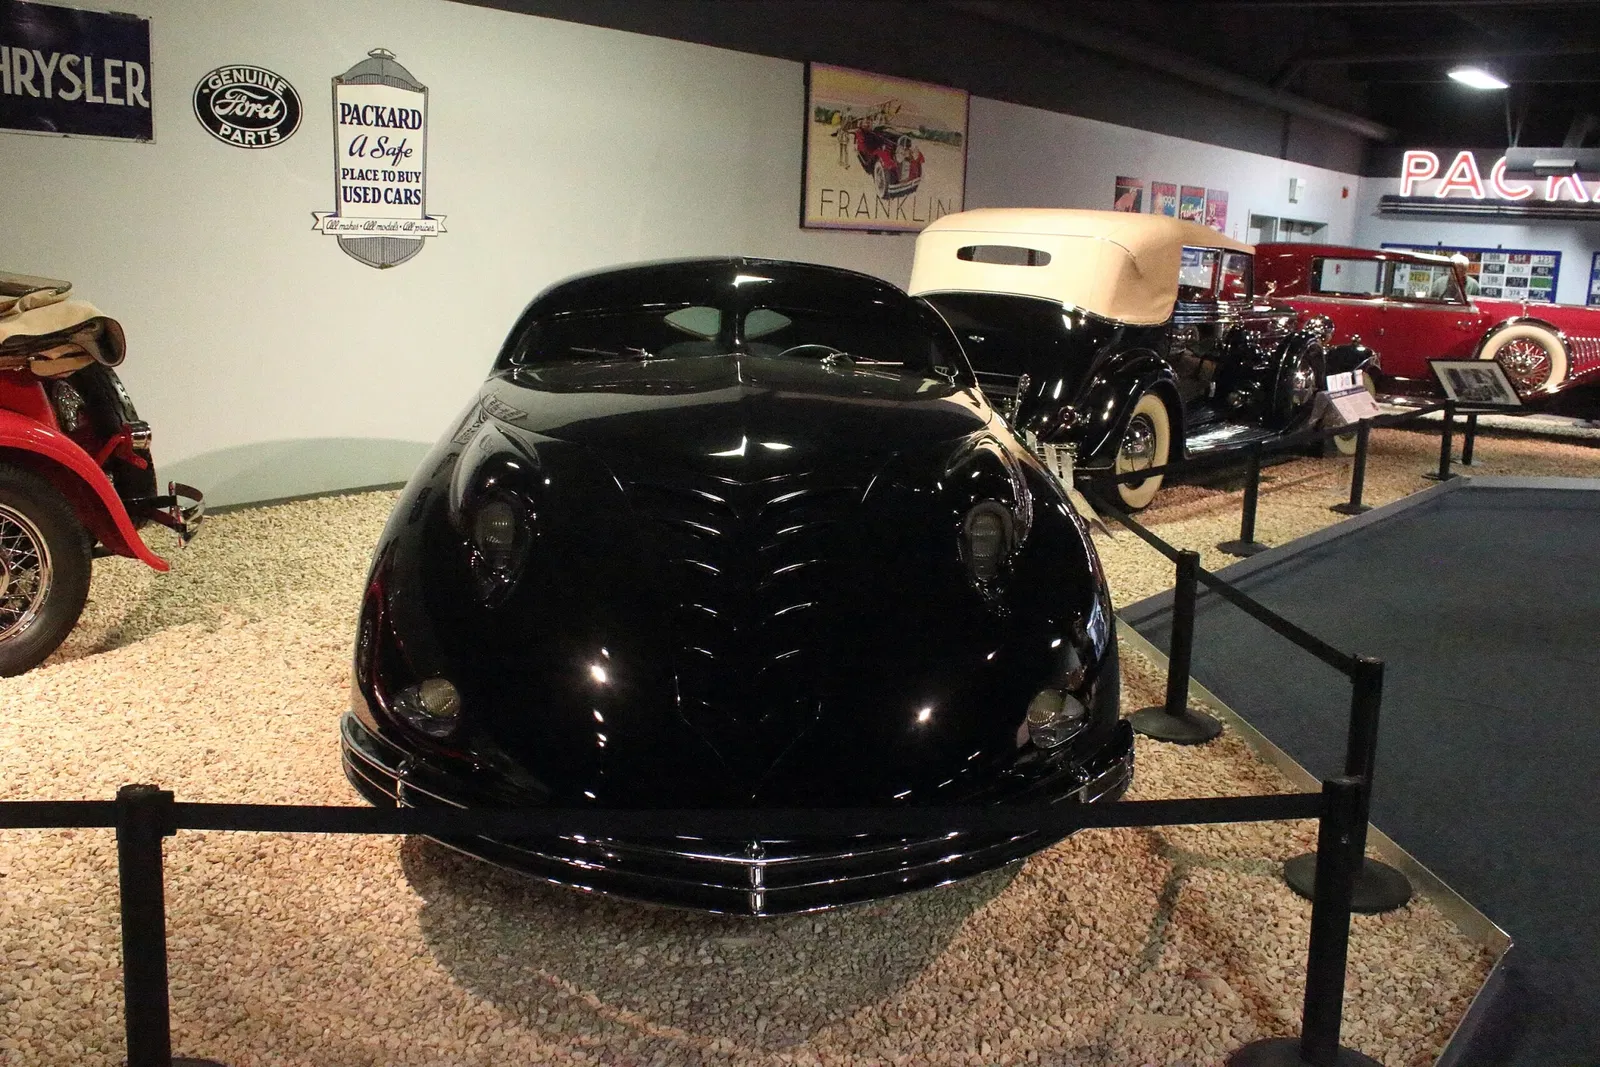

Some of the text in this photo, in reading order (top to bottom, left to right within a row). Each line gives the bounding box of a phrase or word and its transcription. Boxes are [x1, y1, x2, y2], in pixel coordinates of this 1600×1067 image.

[208, 69, 287, 96] GENUINE
[214, 88, 281, 119] Ford
[340, 102, 422, 130] PACKARD
[220, 124, 280, 144] PARTS
[348, 134, 413, 167] A Safe
[342, 168, 421, 183] PLACE TO BUY
[1400, 150, 1600, 202] PACK
[342, 186, 421, 205] USED CARS
[820, 188, 952, 223] FRANKLIN
[326, 220, 340, 230] All
